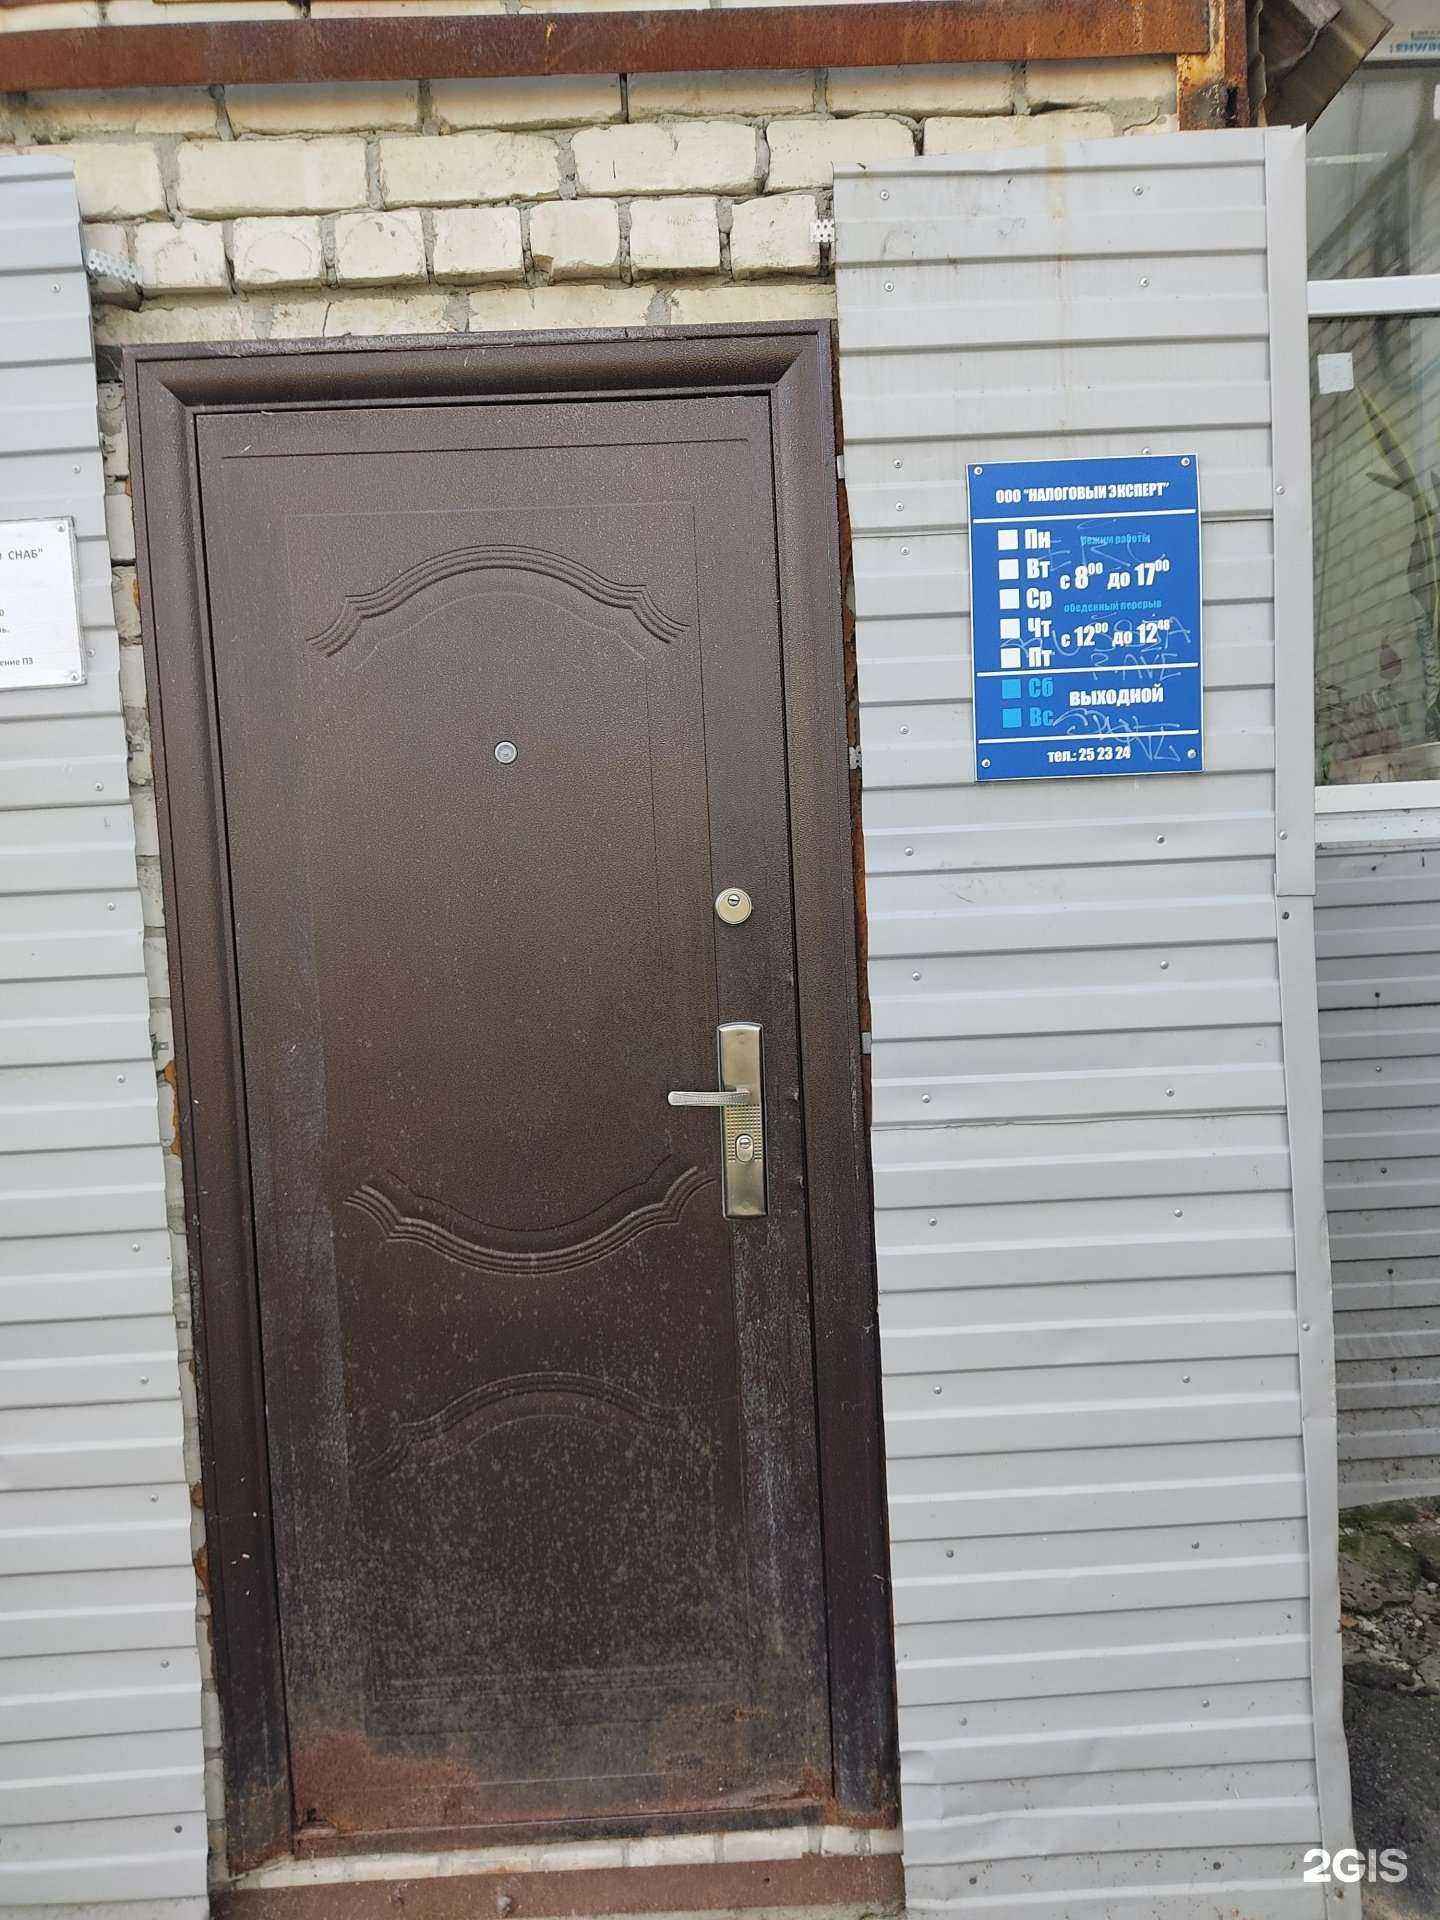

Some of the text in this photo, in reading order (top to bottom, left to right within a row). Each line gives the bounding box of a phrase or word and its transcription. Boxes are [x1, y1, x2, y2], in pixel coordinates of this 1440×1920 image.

[995, 489, 1021, 504] ООО
[1026, 558, 1050, 579] Вт
[1107, 572, 1132, 590] до
[1026, 587, 1053, 610] Ср
[1027, 617, 1052, 638] Чт
[1112, 631, 1133, 647] до
[1027, 646, 1053, 668] Пт
[1028, 678, 1054, 698] Сб
[1029, 707, 1054, 727] Вс
[1078, 748, 1095, 761] 25
[1096, 747, 1114, 761] 23
[1115, 746, 1132, 760] 24
